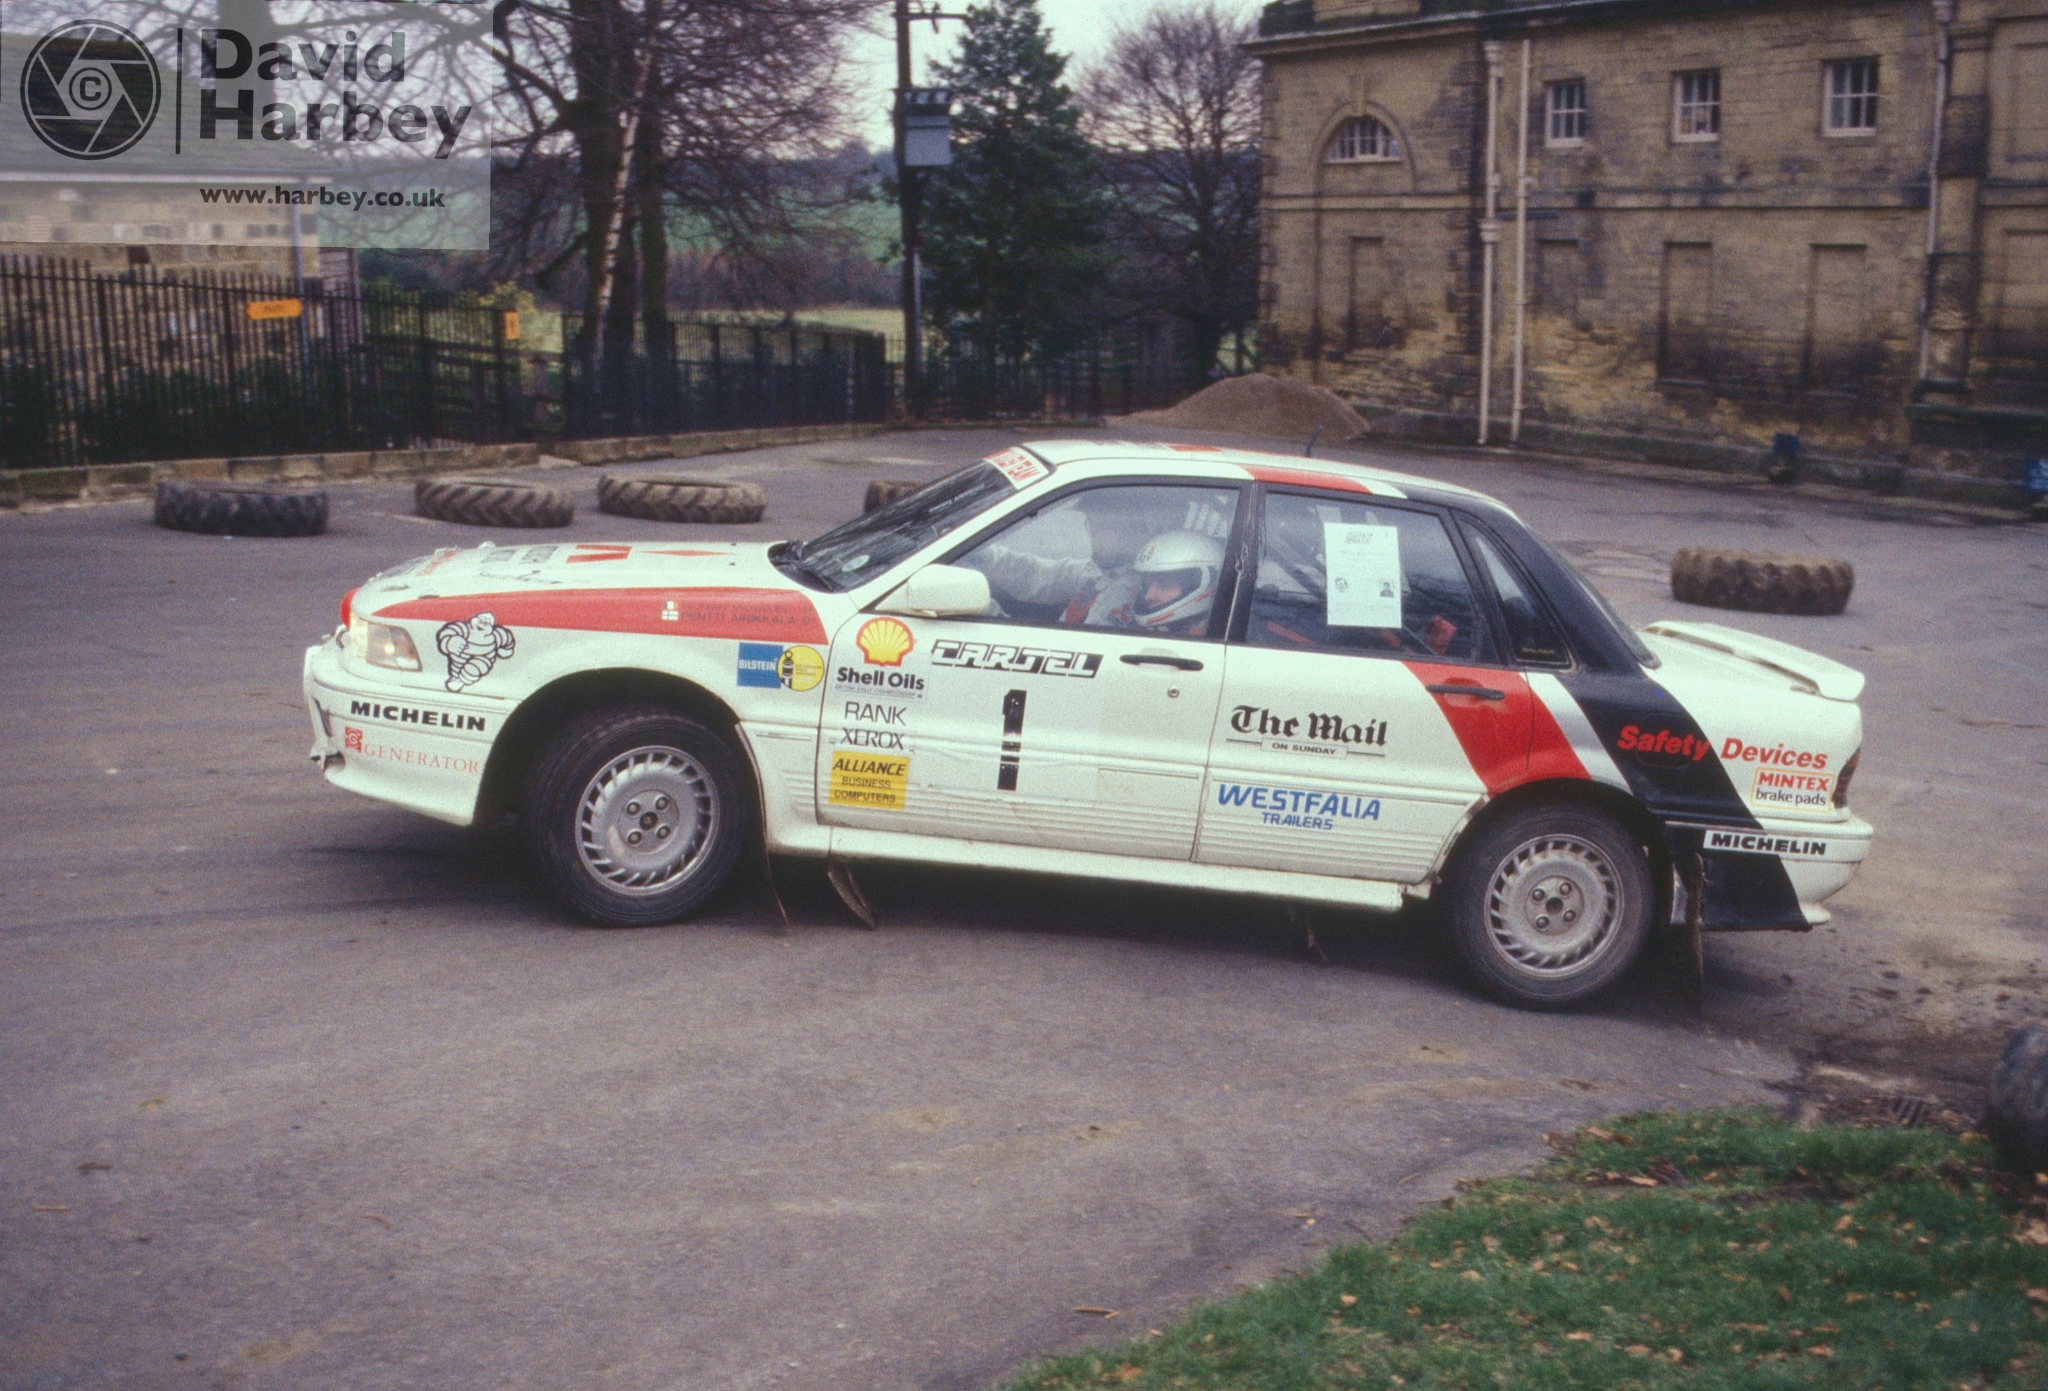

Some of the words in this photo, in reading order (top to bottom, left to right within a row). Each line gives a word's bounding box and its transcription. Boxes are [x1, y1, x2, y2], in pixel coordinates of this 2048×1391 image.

[738, 659, 776, 671] BILSTEIN
[931, 639, 1104, 678] CARTEL
[837, 666, 884, 686] Shell
[888, 672, 924, 690] Oils
[351, 700, 486, 731] MICHELIN
[845, 701, 907, 726] RANK
[1231, 705, 1299, 737] The
[1307, 712, 1387, 746] Mail
[841, 727, 904, 750] XEROX
[997, 689, 1027, 791] 1
[1292, 745, 1336, 755] SUNDAY
[1617, 726, 1710, 760] Safety
[1721, 737, 1827, 769] Devices
[364, 743, 479, 773] GENERATOR
[833, 758, 906, 776] ALLIANCE
[842, 776, 891, 789] BUSINESS
[1758, 771, 1829, 792] MINTEX
[834, 790, 896, 803] COMPUTERS
[1218, 784, 1381, 821] WESTFALIA
[1756, 788, 1792, 803] brake
[1796, 792, 1827, 806] pads
[1262, 812, 1333, 830] TRAILERS
[1711, 833, 1826, 855] MICHELIN
